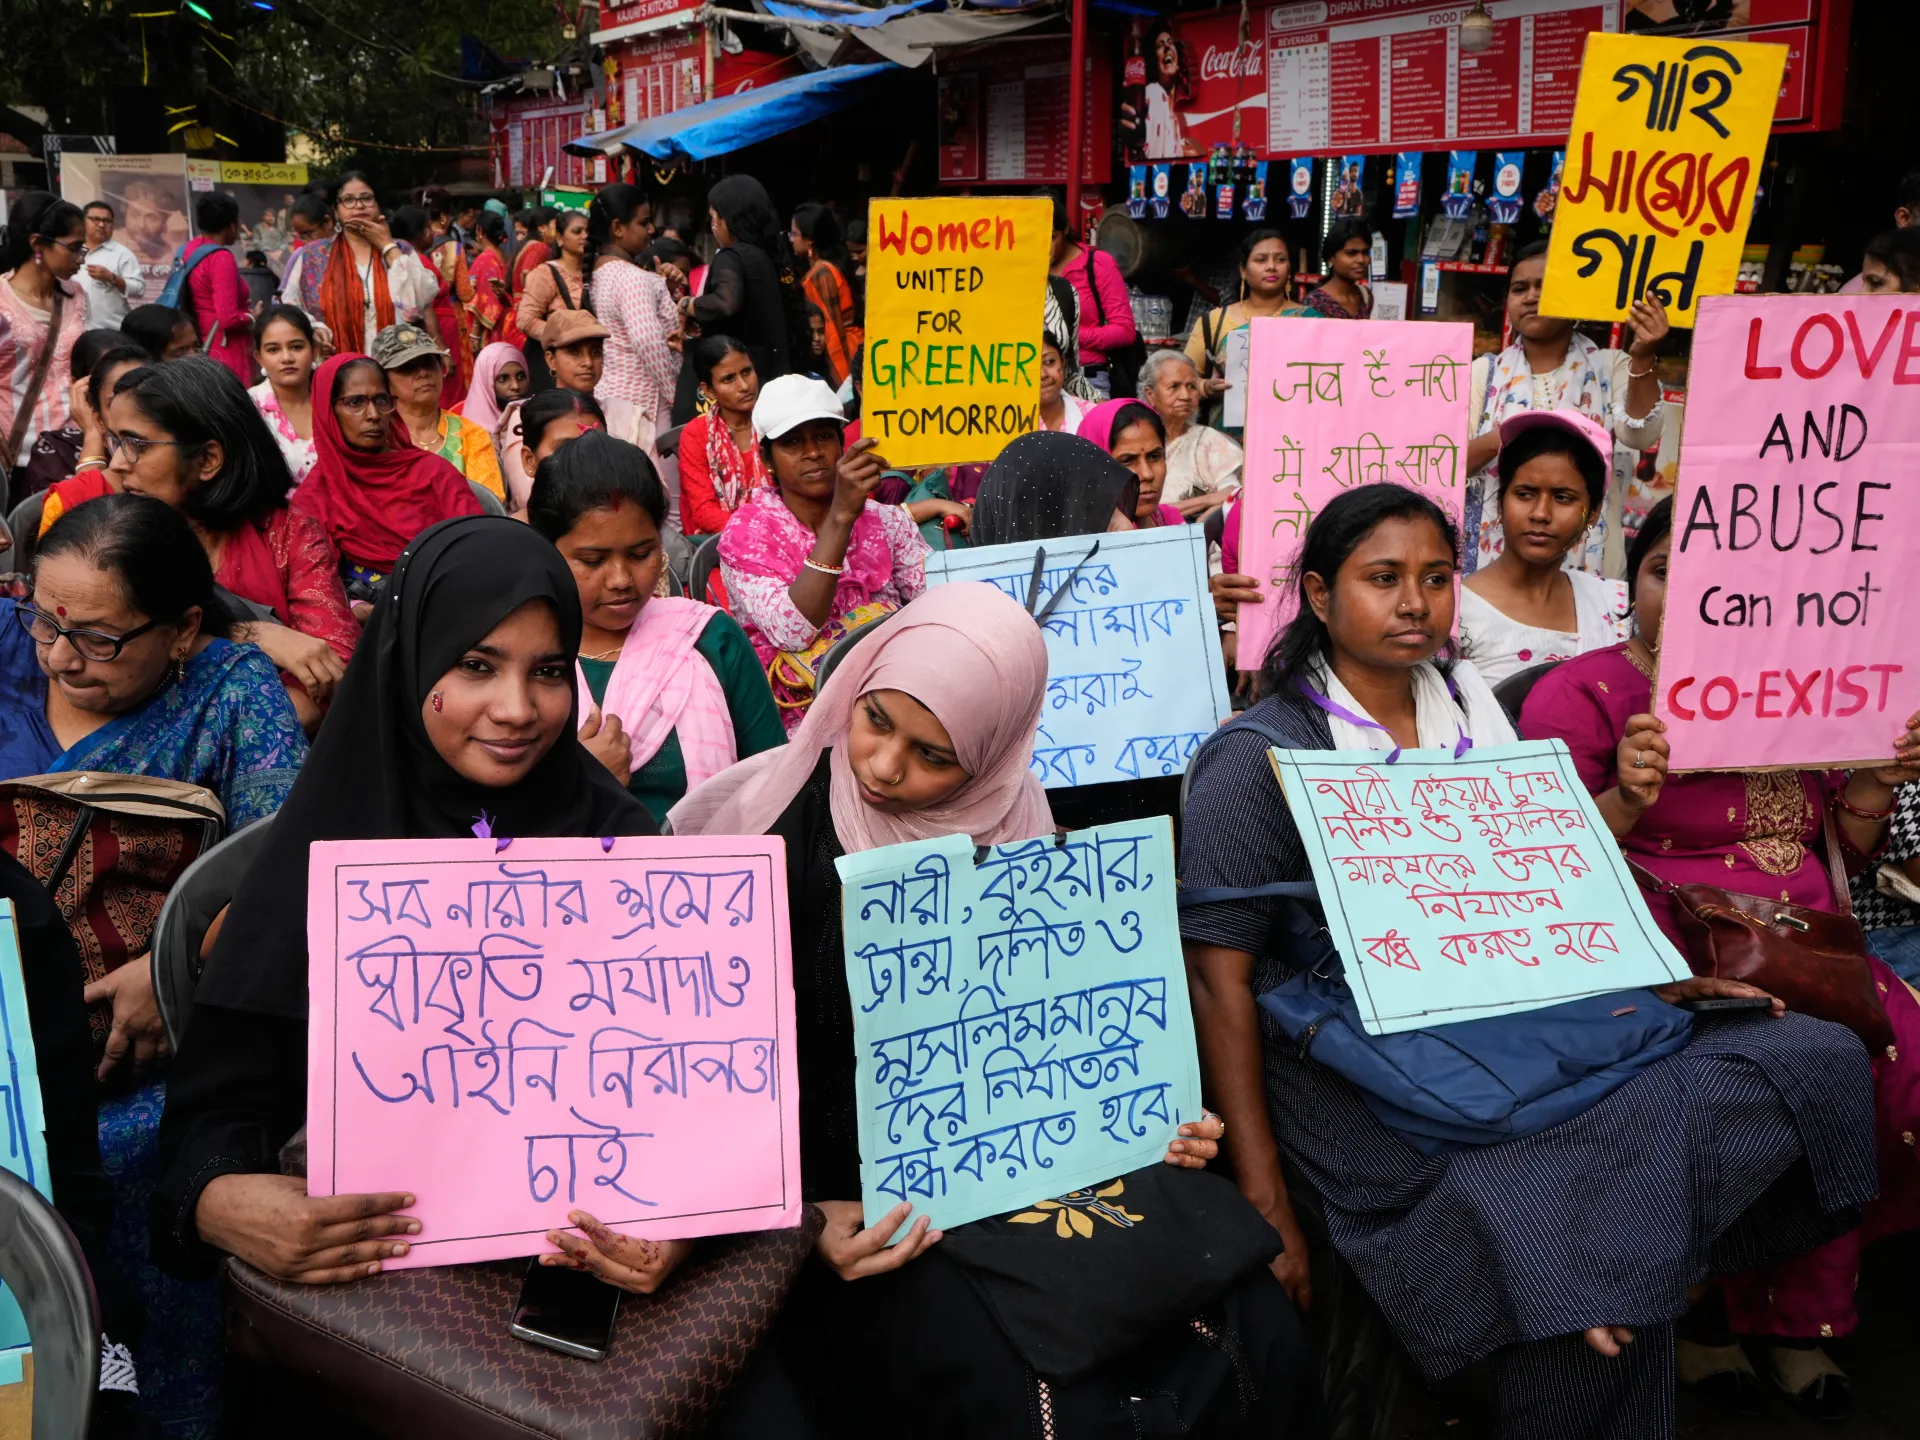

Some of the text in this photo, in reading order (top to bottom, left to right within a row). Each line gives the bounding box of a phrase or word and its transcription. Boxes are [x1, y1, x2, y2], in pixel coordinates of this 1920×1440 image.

[1329, 1, 1362, 16] DIPAK
[1428, 6, 1493, 27] FOOD ITS
[1278, 33, 1319, 47] BEVERAGES
[1612, 46, 1742, 139] গাহি
[1563, 131, 1751, 238] সাম্যের
[878, 210, 1016, 257] Women
[896, 267, 984, 294] UNITED
[1572, 229, 1704, 311] গান
[917, 310, 963, 336] FOR
[1744, 308, 1920, 386] LOVE
[871, 339, 1037, 399] GREENER
[1273, 349, 1468, 407] जब है नारी
[872, 402, 1037, 438] TOMORROW
[1759, 403, 1868, 463] AND
[1273, 435, 1306, 488] में
[1395, 434, 1460, 488] सारी
[1679, 481, 1891, 555] ABUSE
[1796, 572, 1882, 628] not
[1047, 658, 1153, 716] মরাই
[1667, 664, 1904, 721] CO-EXIST
[1419, 815, 1462, 842] ও
[346, 863, 755, 940] সব নারীর শ্রমের
[860, 853, 973, 925] নারী,
[978, 907, 1086, 996] দলিত
[1095, 910, 1143, 954] ও
[1437, 928, 1540, 967] করতে
[1545, 922, 1620, 964] হবে
[351, 1017, 577, 1116] আইনি
[875, 1038, 1144, 1146] দের নির্যাতন
[524, 1105, 659, 1208] চাই
[875, 1144, 948, 1202] বন্ধ
[947, 1110, 1077, 1182] করতে
